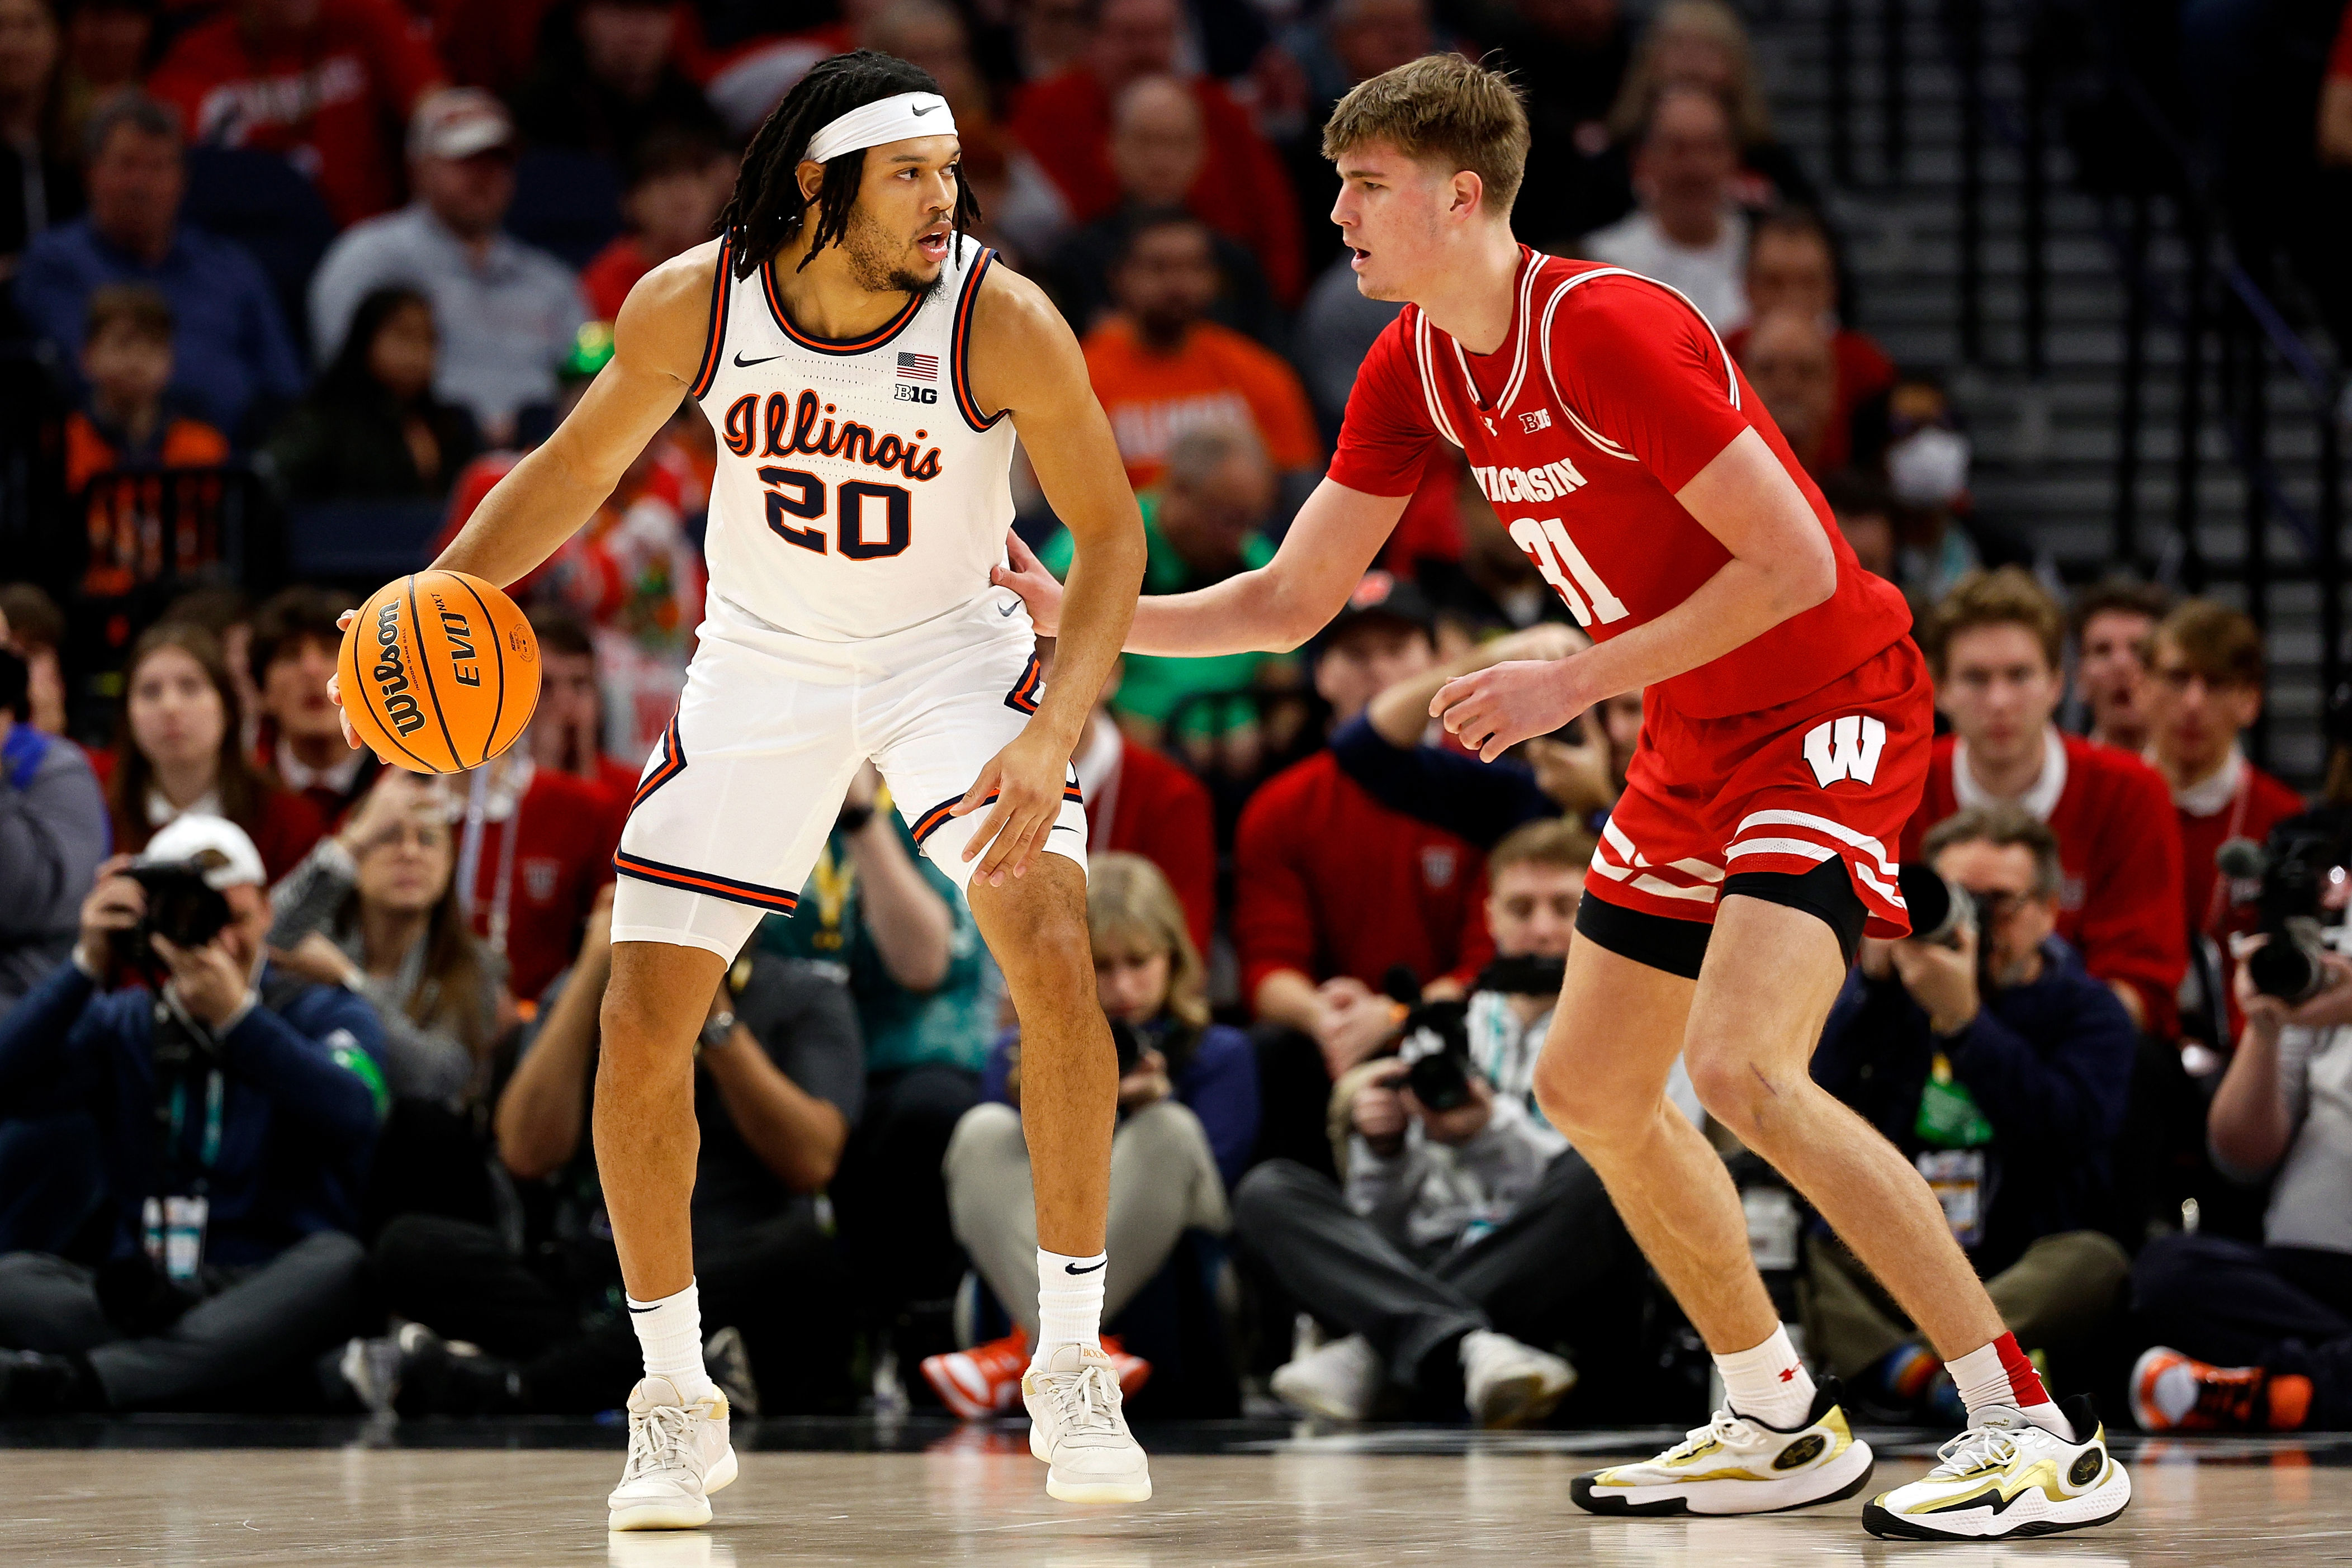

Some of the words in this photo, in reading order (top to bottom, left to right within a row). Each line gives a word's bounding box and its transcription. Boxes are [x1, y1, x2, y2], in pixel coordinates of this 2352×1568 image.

[722, 389, 943, 481] Illinois
[757, 465, 912, 561] 20
[430, 593, 447, 611] NXT
[1509, 518, 1630, 627] 31
[373, 599, 427, 738] Wilson
[409, 666, 420, 691] INDOOR
[440, 612, 481, 688] EVO
[1802, 715, 1887, 790] W
